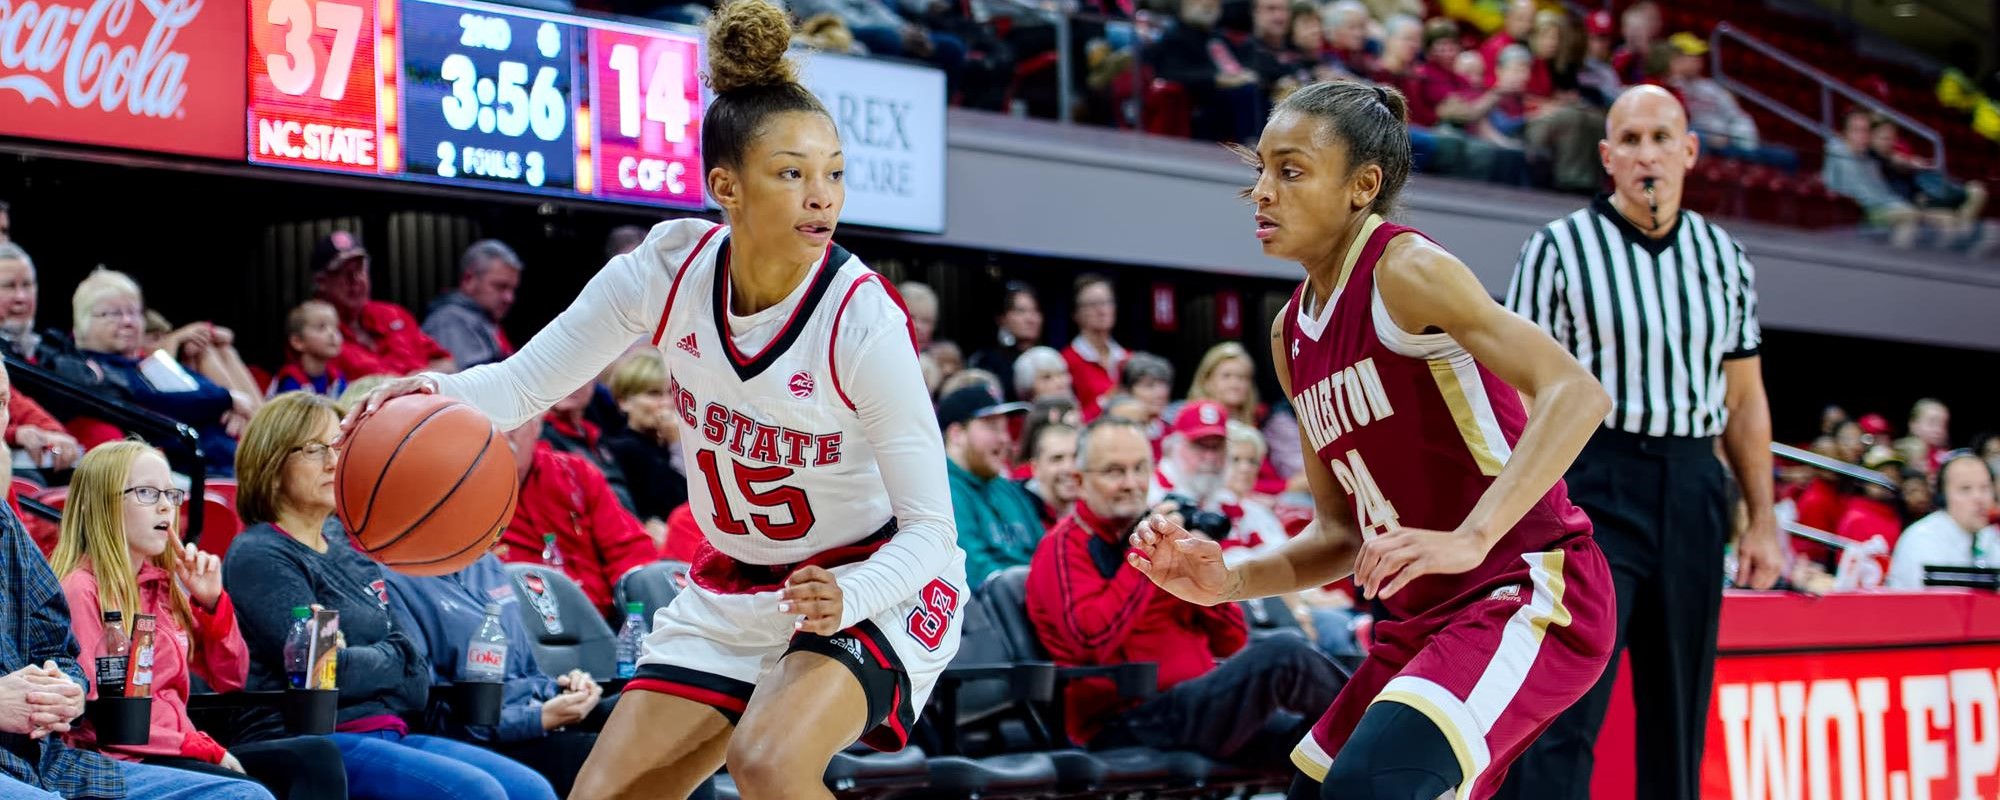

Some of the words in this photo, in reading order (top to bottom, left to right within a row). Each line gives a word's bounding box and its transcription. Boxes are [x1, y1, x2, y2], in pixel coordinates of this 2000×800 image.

[0, 0, 204, 119] ca-Cola
[266, 0, 364, 101] 37
[441, 53, 566, 141] 3:56
[609, 43, 690, 143] 14
[838, 94, 912, 152] REX
[259, 118, 302, 158] NC
[302, 123, 375, 166] STATE
[437, 141, 457, 178] 2
[525, 151, 545, 187] 3
[676, 341, 701, 359] adidas
[702, 402, 843, 468] STATE
[696, 448, 816, 541] 15
[1331, 448, 1401, 542] 24
[469, 648, 502, 667] Coke
[829, 638, 865, 665] adidas
[1718, 667, 2000, 800] WOLFP
